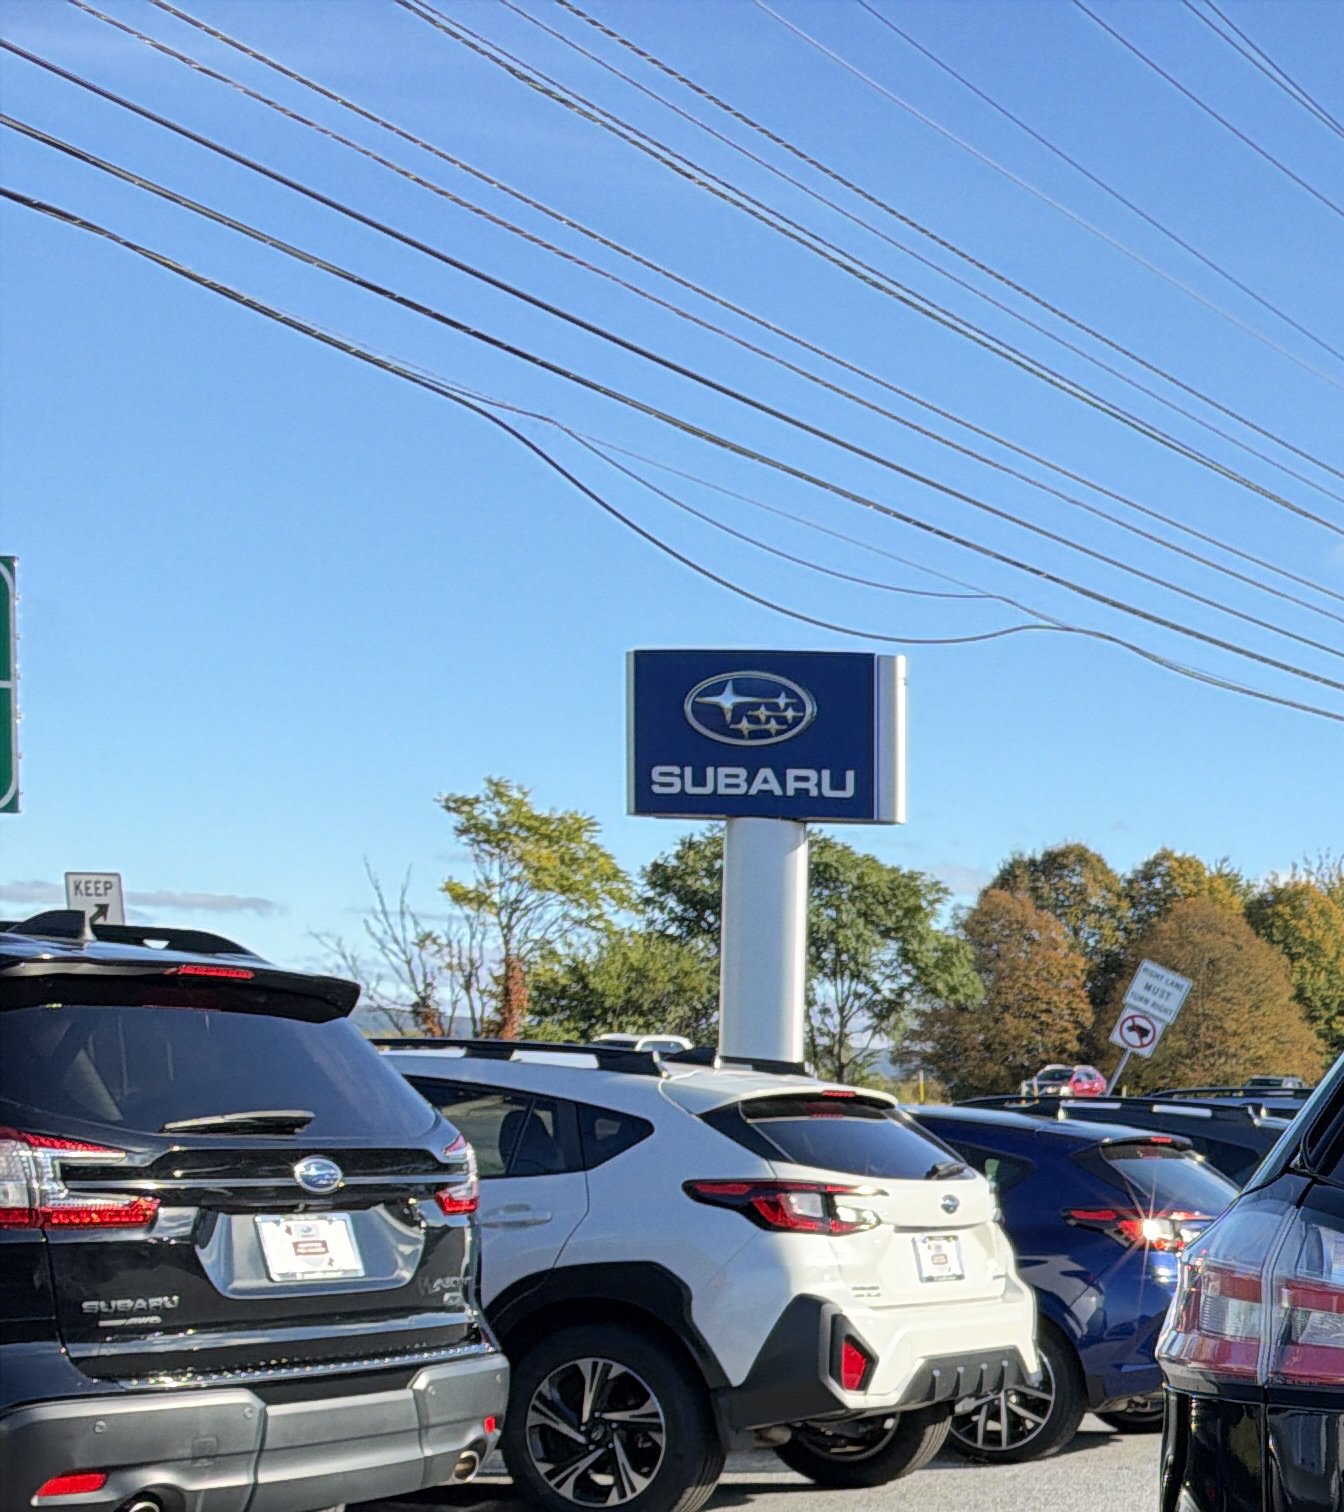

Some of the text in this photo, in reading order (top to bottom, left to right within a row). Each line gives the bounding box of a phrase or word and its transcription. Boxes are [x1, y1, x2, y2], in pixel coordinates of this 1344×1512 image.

[651, 765, 855, 798] SUBARU
[73, 880, 113, 897] KEEP
[1143, 982, 1172, 1000] MUST
[1165, 978, 1184, 992] LANE
[82, 1295, 179, 1313] SUBARU
